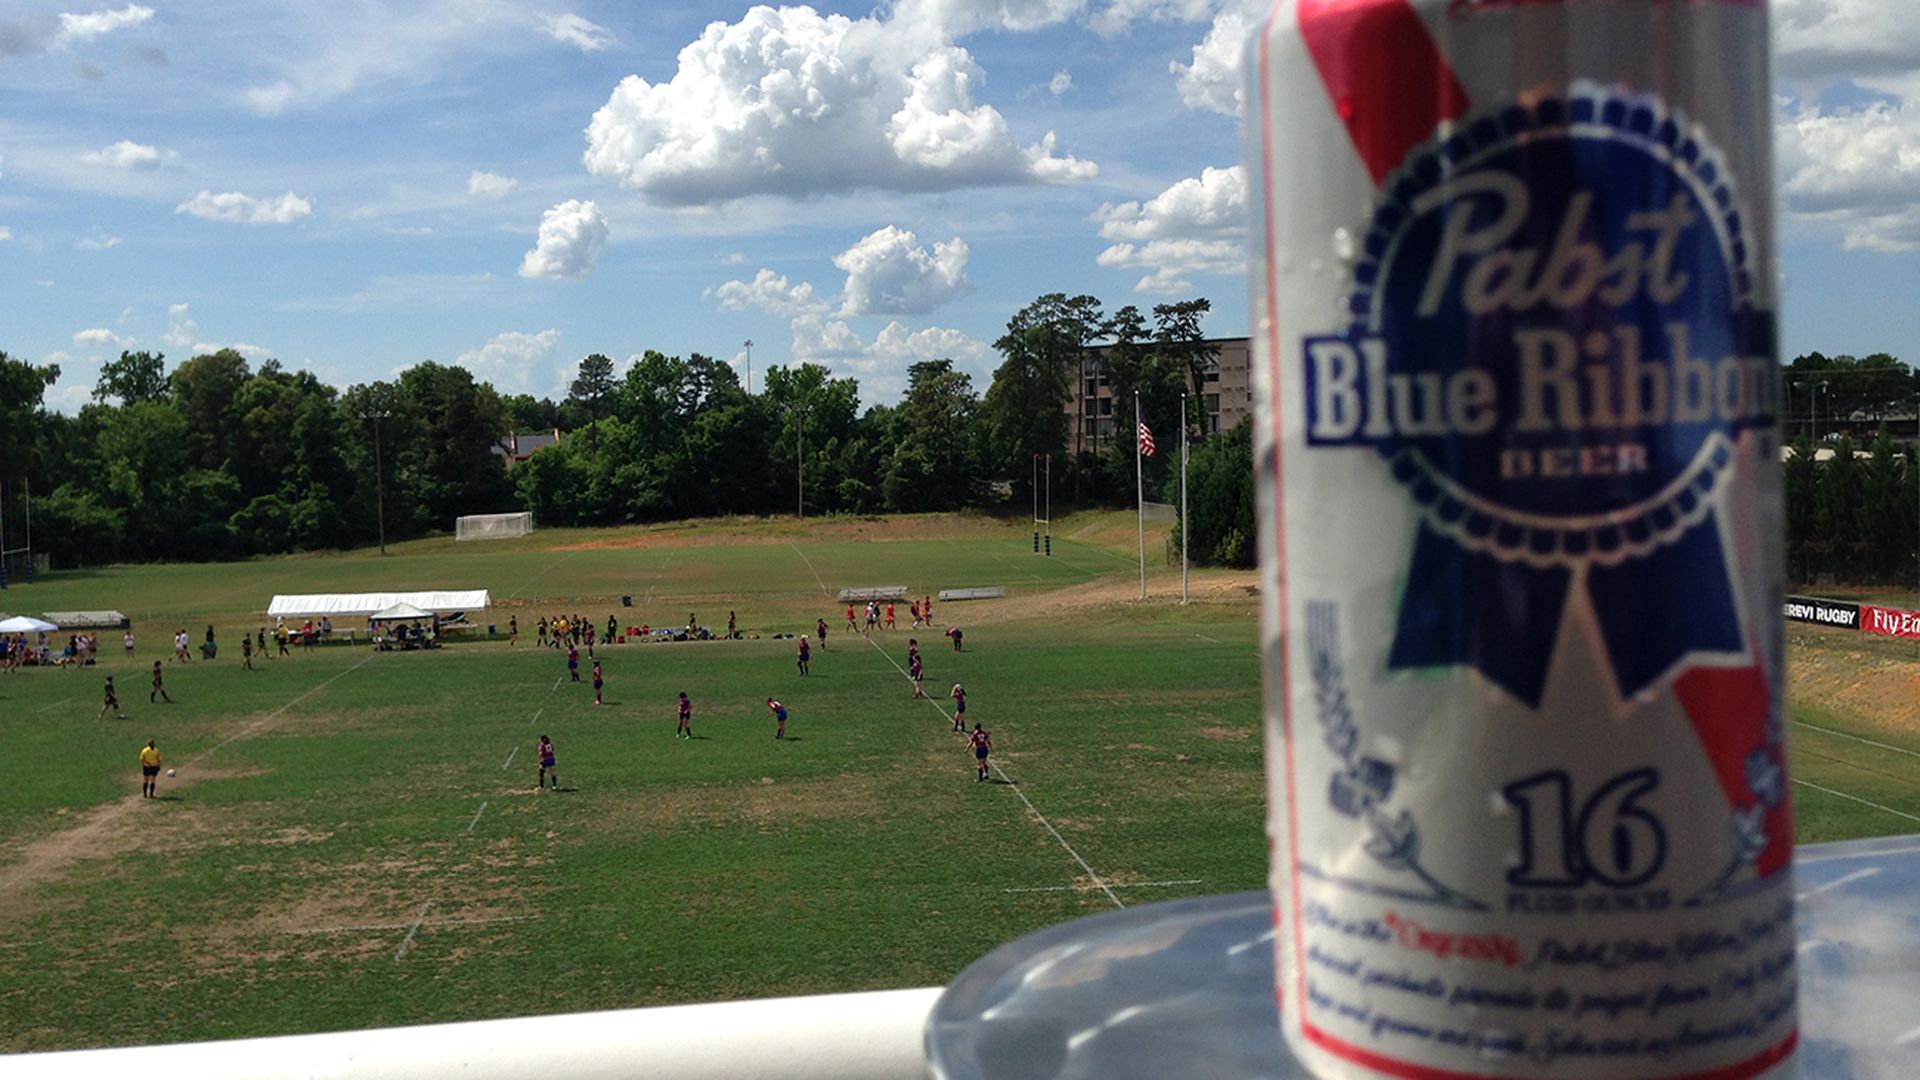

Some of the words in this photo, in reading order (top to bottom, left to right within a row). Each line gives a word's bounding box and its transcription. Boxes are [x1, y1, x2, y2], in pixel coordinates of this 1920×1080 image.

[1412, 171, 1697, 317] Pabst
[1311, 337, 1497, 439] Blue
[1500, 443, 1650, 478] BEER
[1816, 606, 1856, 624] RUGBY
[1873, 609, 1899, 635] Fly
[1504, 766, 1668, 889] 16
